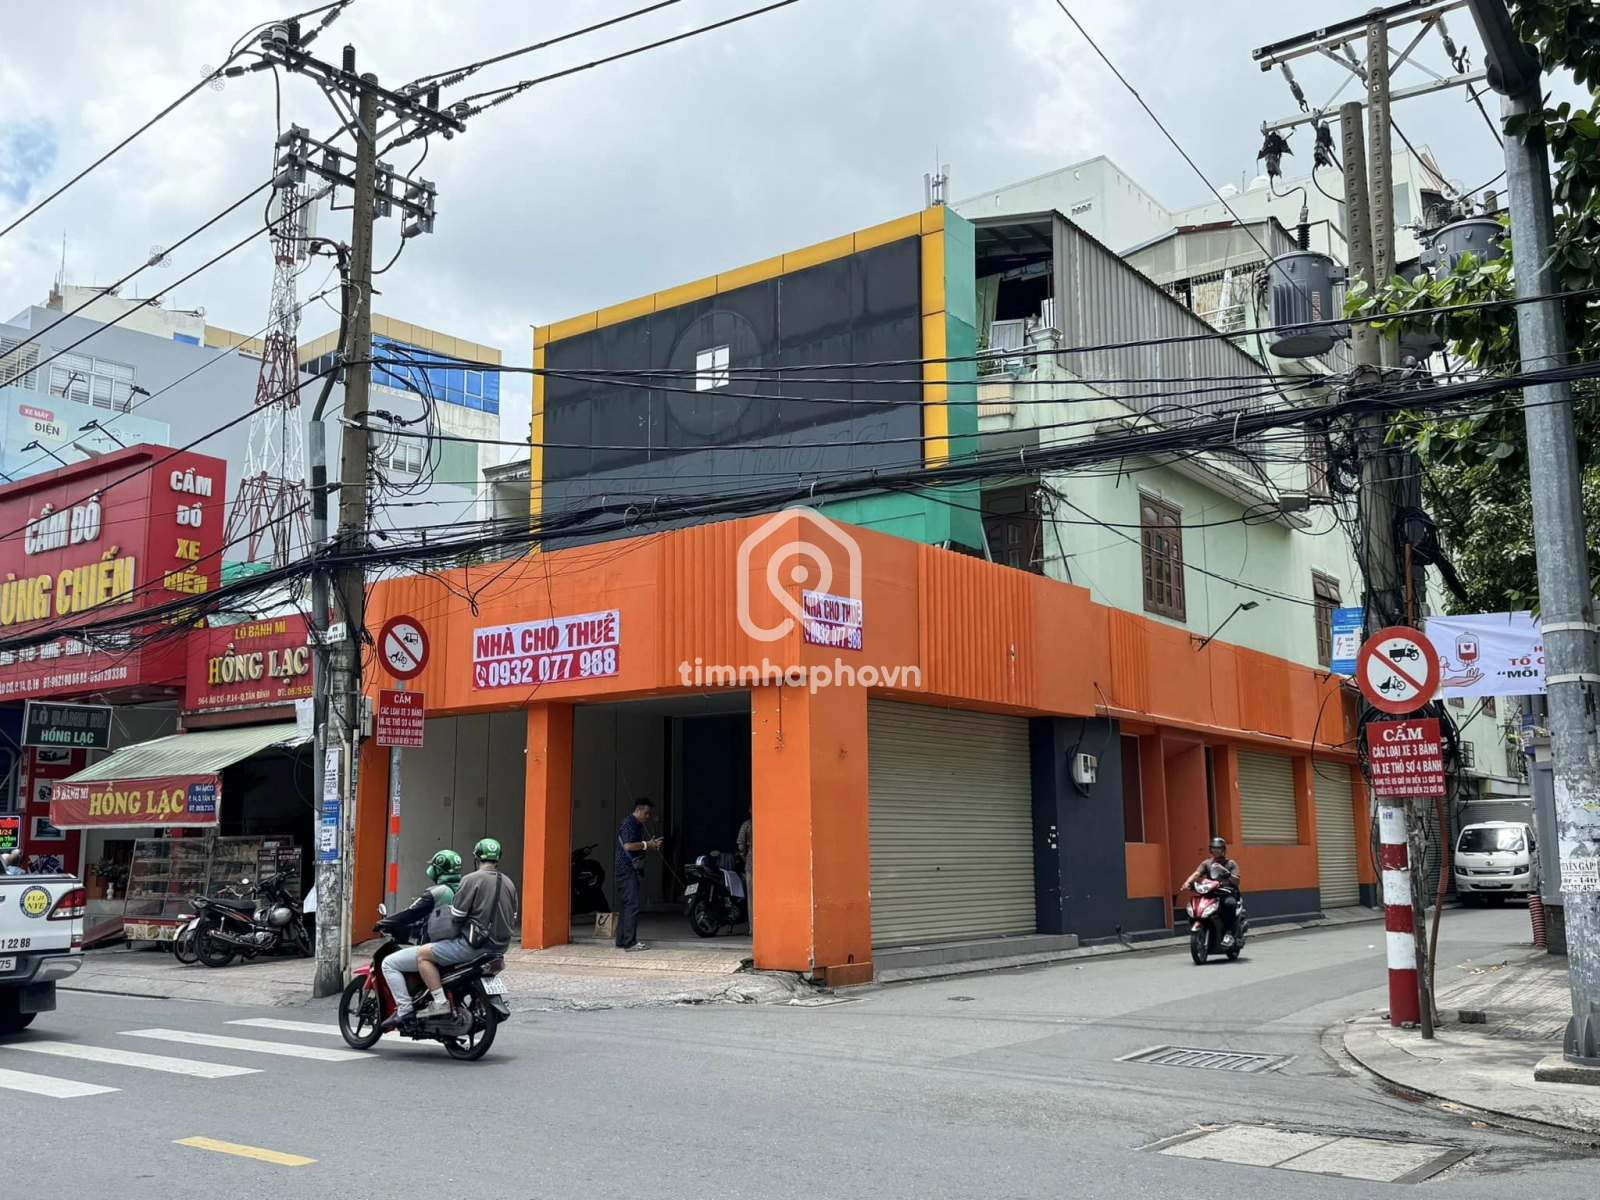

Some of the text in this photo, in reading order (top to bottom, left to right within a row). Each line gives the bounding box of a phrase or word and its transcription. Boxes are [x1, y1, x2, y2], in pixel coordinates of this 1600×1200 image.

[34, 422, 60, 436] ĐIỆN
[175, 538, 201, 561] XE
[0, 573, 52, 626] ÙNG
[56, 546, 135, 616] CHIẾN
[824, 600, 839, 621] CHO
[235, 624, 246, 640] LÒ
[476, 613, 615, 658] NHÀ CHO THUÊ
[811, 621, 861, 650] 0932 077 988
[208, 643, 309, 684] HỒNG LẠC
[488, 648, 616, 687] 0932 077 988
[1508, 653, 1531, 666] TỔ
[73, 731, 94, 746] LẠC
[1382, 722, 1424, 742] CẤM
[1372, 740, 1438, 759] CÁC LOẠI XE 3 BÁNH
[1372, 757, 1442, 775] VÀ XE THÔ SƠ 4 BÁNH
[89, 781, 185, 820] HỒNG LẠC
[7, 938, 18, 949] 22
[20, 937, 31, 948] 88
